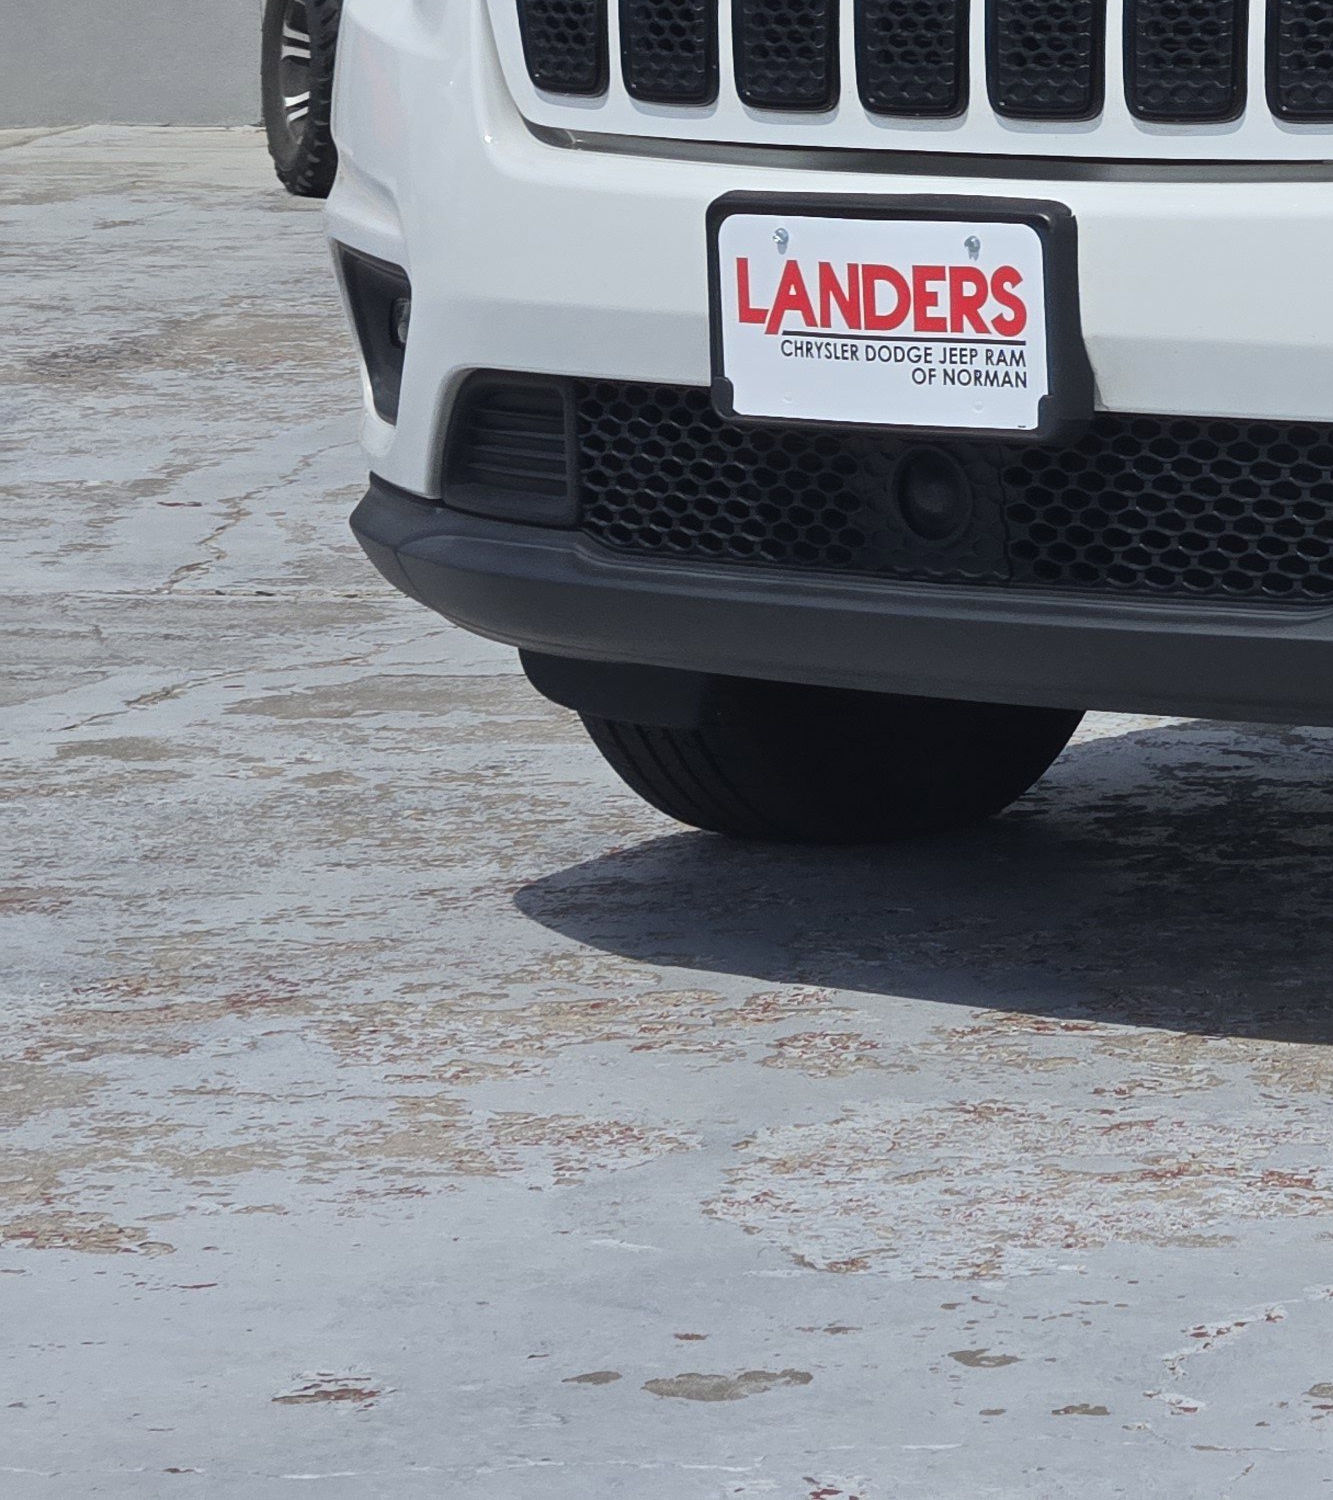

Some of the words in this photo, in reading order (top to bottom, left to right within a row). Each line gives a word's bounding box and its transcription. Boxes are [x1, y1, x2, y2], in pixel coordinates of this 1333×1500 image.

[735, 257, 1028, 338] LANDERS
[780, 338, 860, 360] CHRYSLER
[865, 344, 933, 363] DODGE
[937, 346, 979, 365] JEEP
[985, 348, 1026, 367] RAM
[911, 367, 937, 385] OF
[942, 368, 1027, 388] NORMAN
